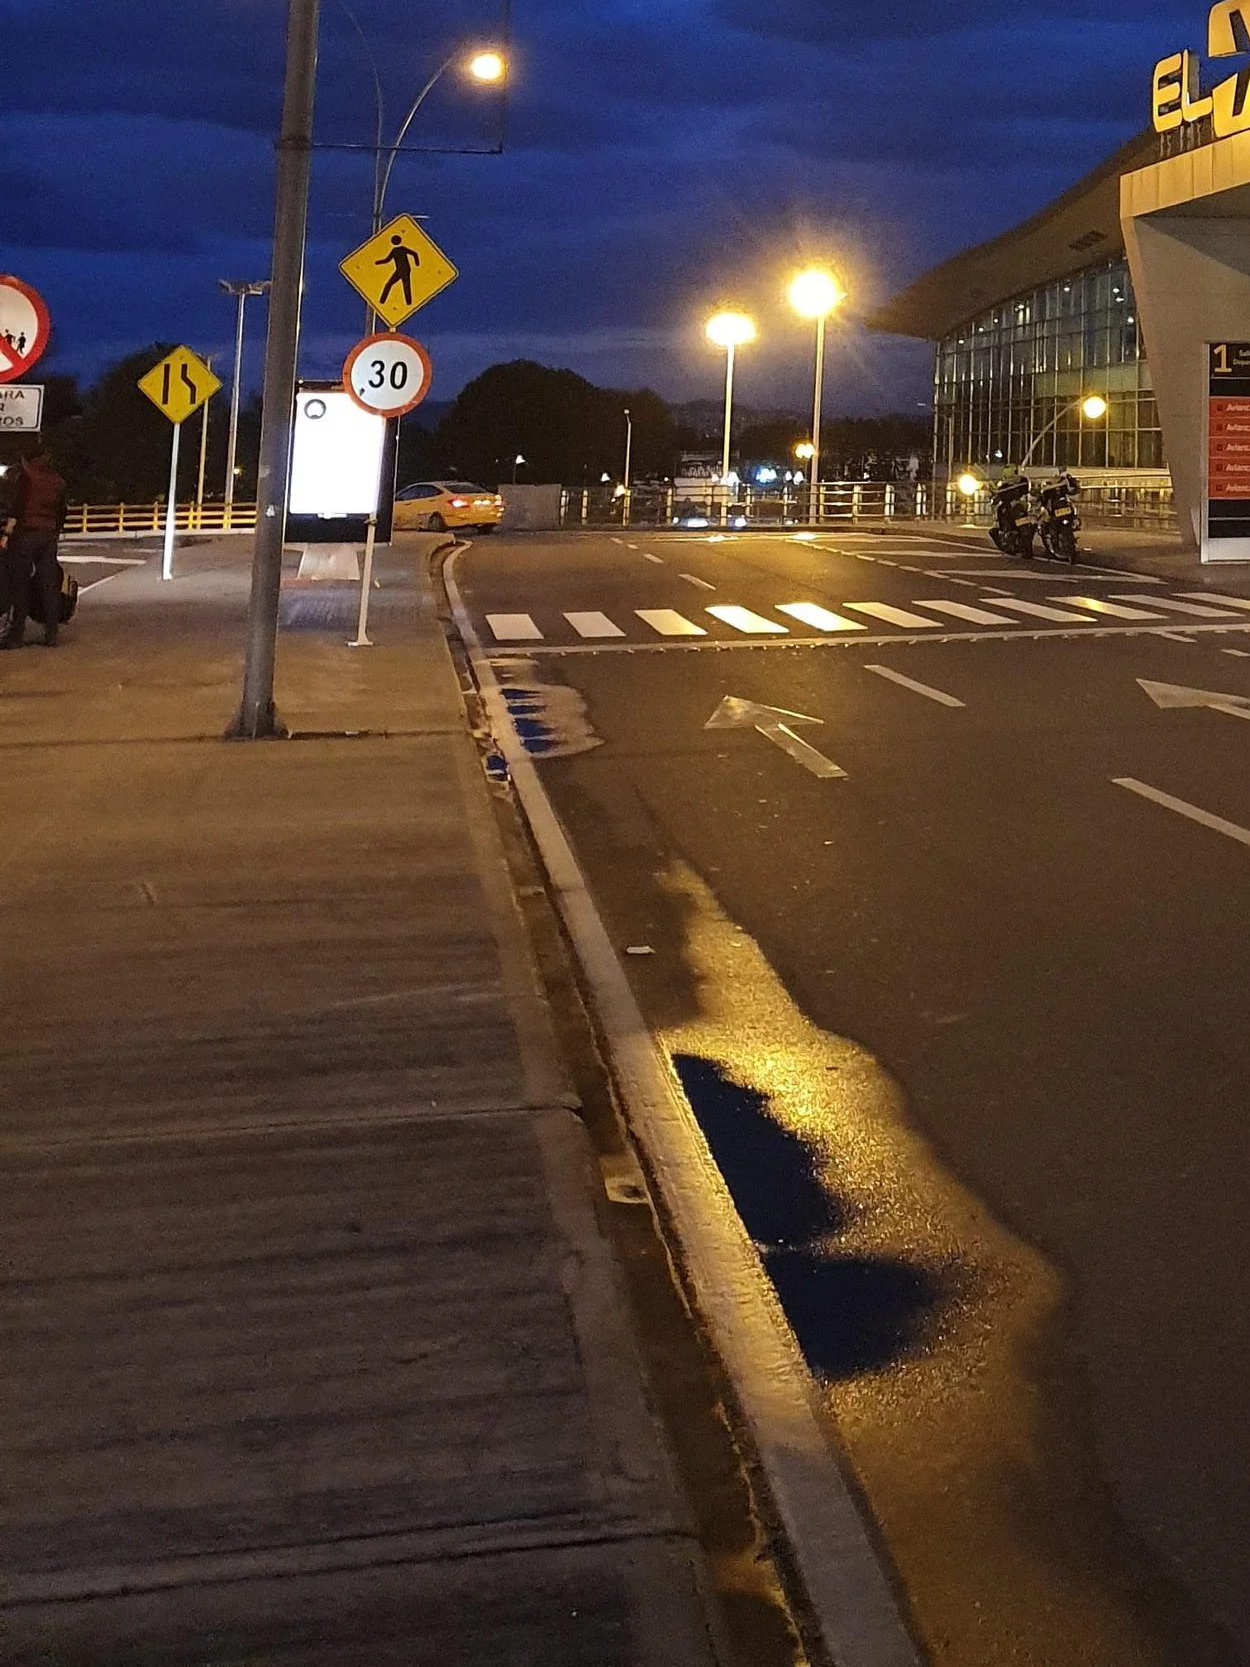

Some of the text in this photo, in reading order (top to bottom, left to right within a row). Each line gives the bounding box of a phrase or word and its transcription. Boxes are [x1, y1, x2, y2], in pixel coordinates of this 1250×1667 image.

[1153, 49, 1212, 133] EL
[1213, 344, 1232, 372] 1
[368, 360, 408, 390] 30
